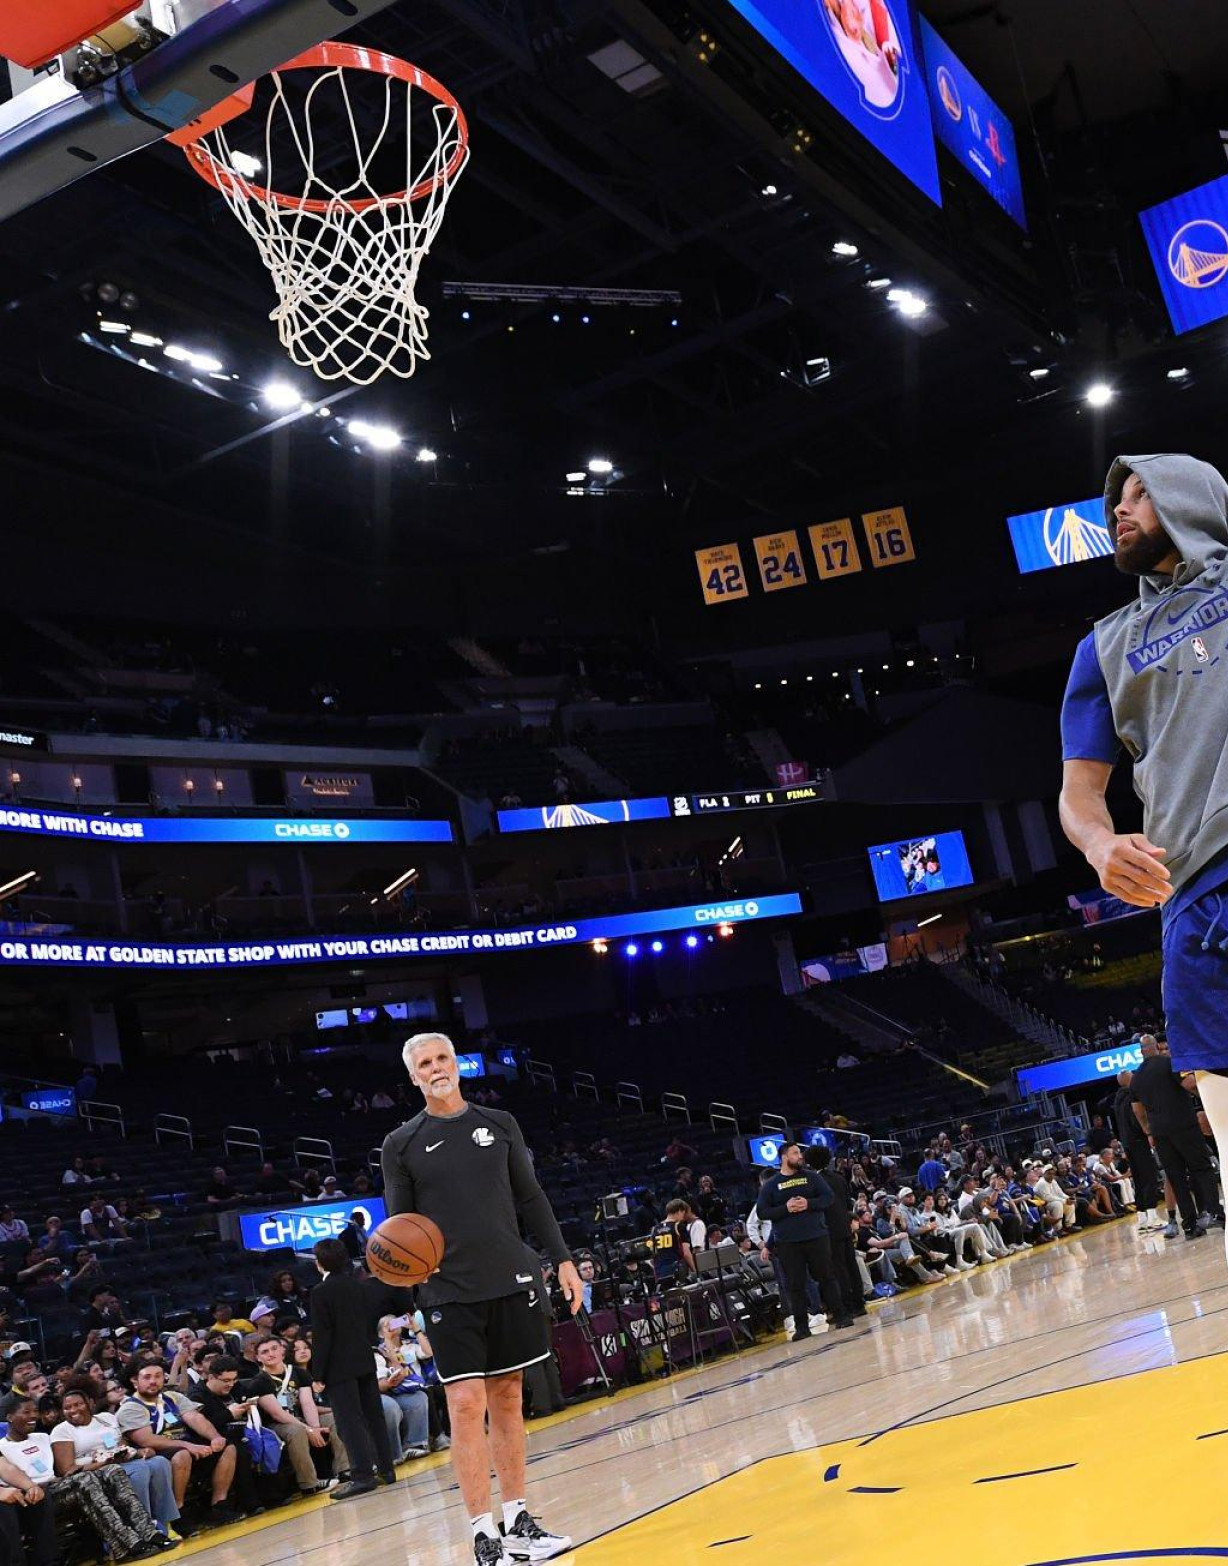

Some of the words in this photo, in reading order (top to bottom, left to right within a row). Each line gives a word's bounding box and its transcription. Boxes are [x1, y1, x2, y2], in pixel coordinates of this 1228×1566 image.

[821, 540, 849, 571] 17
[874, 528, 907, 560] 16
[706, 564, 743, 595] 42
[762, 552, 801, 585] 24
[786, 788, 817, 800] FINAL
[43, 814, 89, 835] WITH
[90, 820, 145, 838] CHASE
[275, 823, 333, 837] CHASE
[695, 904, 745, 921] CHASE
[1, 942, 29, 959] OR
[31, 943, 83, 961] MORE
[85, 946, 107, 962] AT
[109, 946, 175, 964] GOLDEN
[176, 948, 226, 964] STATE
[228, 945, 275, 962] SHOP
[277, 942, 322, 960] WITH
[323, 940, 369, 957] YOUR
[370, 937, 419, 954] CHASE
[421, 935, 470, 950] CREDIT
[472, 933, 494, 948] OR
[494, 930, 537, 948] DEBIT
[537, 925, 578, 943] CARD
[1096, 1048, 1144, 1073] CHAS
[259, 1210, 348, 1246] CHASE
[655, 1234, 673, 1249] 30
[370, 1241, 410, 1272] Wilson
